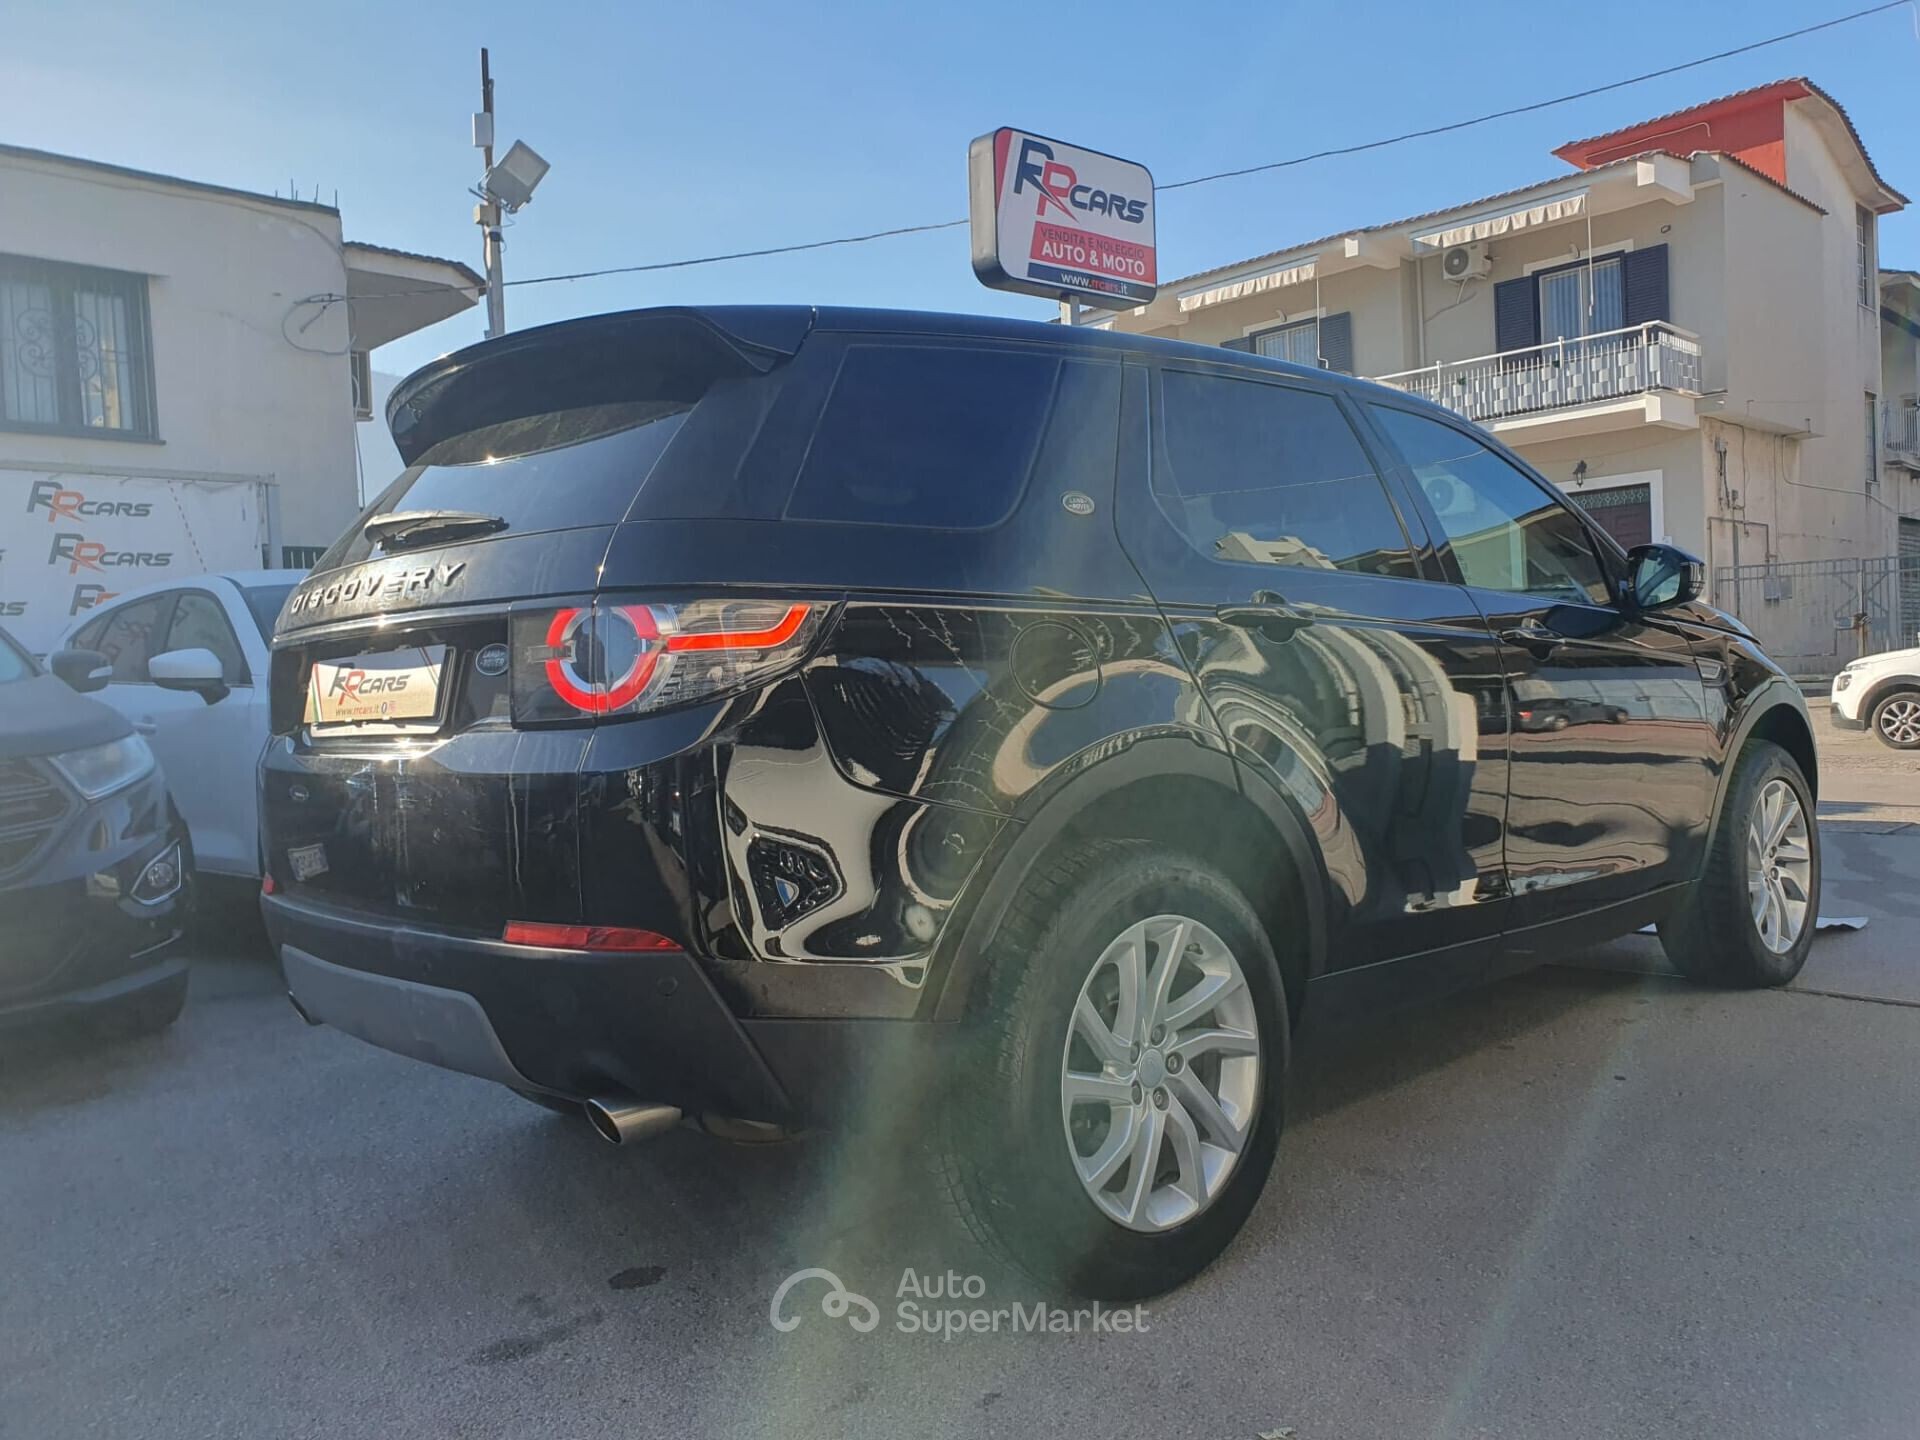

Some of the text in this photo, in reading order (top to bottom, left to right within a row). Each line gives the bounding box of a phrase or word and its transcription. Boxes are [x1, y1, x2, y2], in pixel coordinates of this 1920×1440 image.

[1041, 226, 1145, 259] VENDITA E NOLEGGIO
[1041, 241, 1145, 276] AUTO & MOTO
[1061, 272, 1128, 295] www.rrcars.it
[291, 562, 467, 614] DISCOVERY
